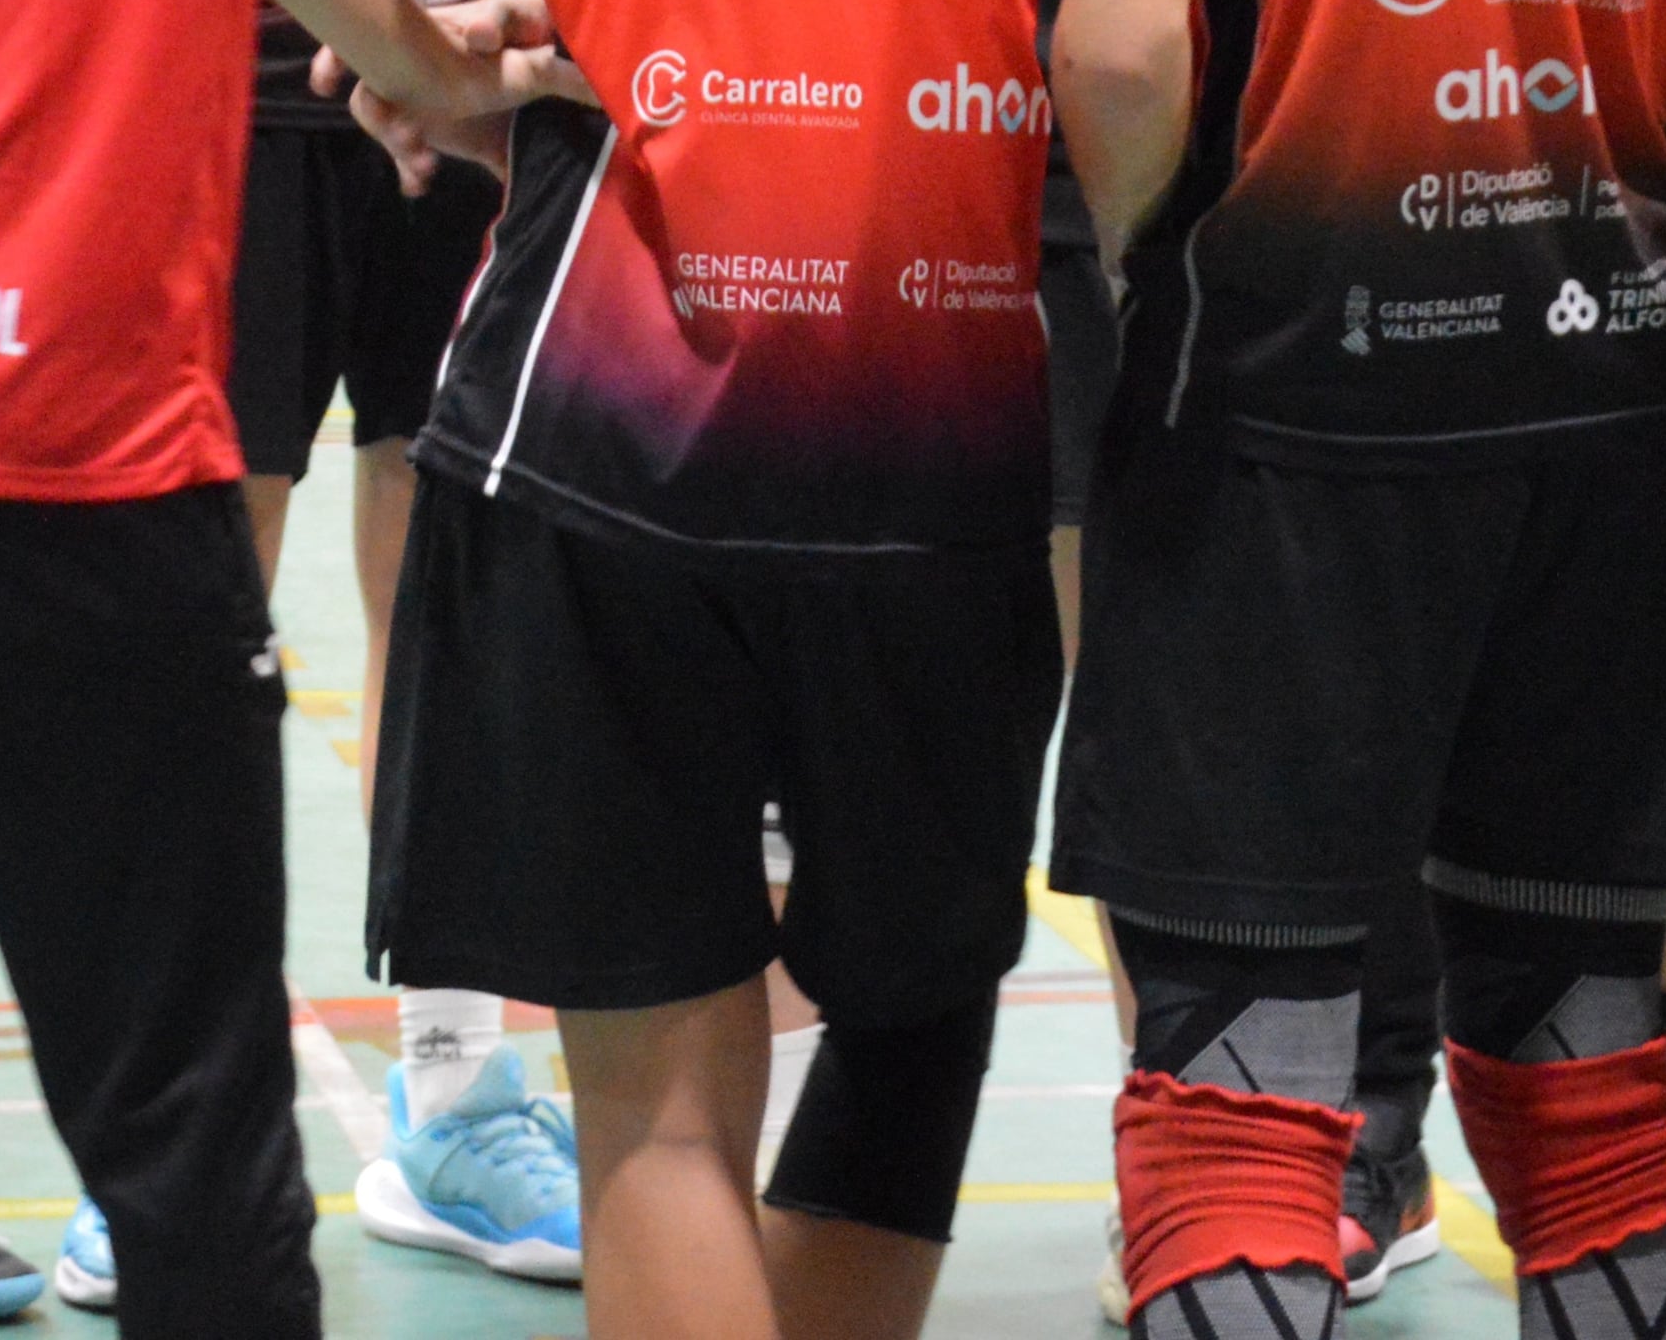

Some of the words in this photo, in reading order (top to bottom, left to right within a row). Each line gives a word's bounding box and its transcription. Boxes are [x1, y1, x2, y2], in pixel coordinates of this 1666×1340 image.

[701, 69, 864, 110] Carralero
[1460, 205, 1489, 228] de
[678, 253, 850, 284] GENERALITAT
[686, 283, 844, 316] VALENCIANA
[943, 290, 965, 310] de
[1379, 293, 1505, 318] GENERALITAT
[1381, 316, 1502, 340] VALENCIANA
